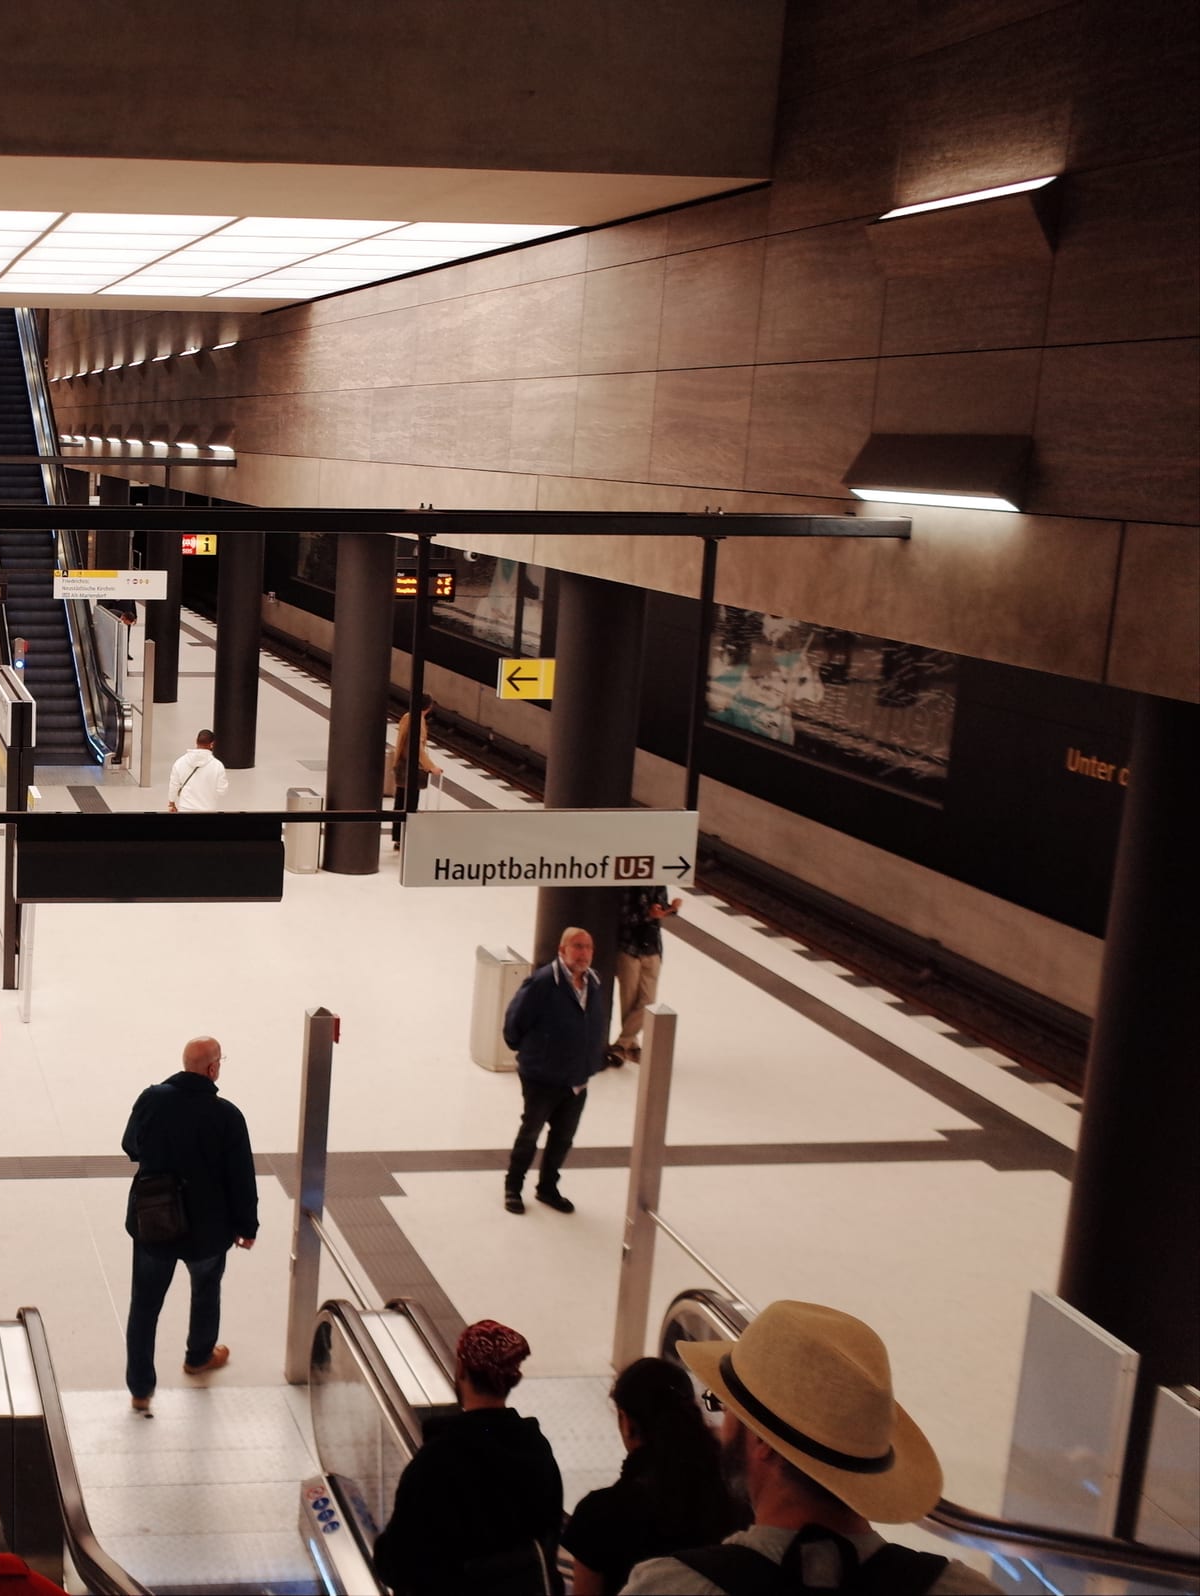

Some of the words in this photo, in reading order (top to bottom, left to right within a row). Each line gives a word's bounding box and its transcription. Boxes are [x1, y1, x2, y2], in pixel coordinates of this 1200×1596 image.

[1067, 747, 1116, 782] Unter
[434, 856, 609, 886] Hauptbahnhof
[617, 857, 651, 879] U5
